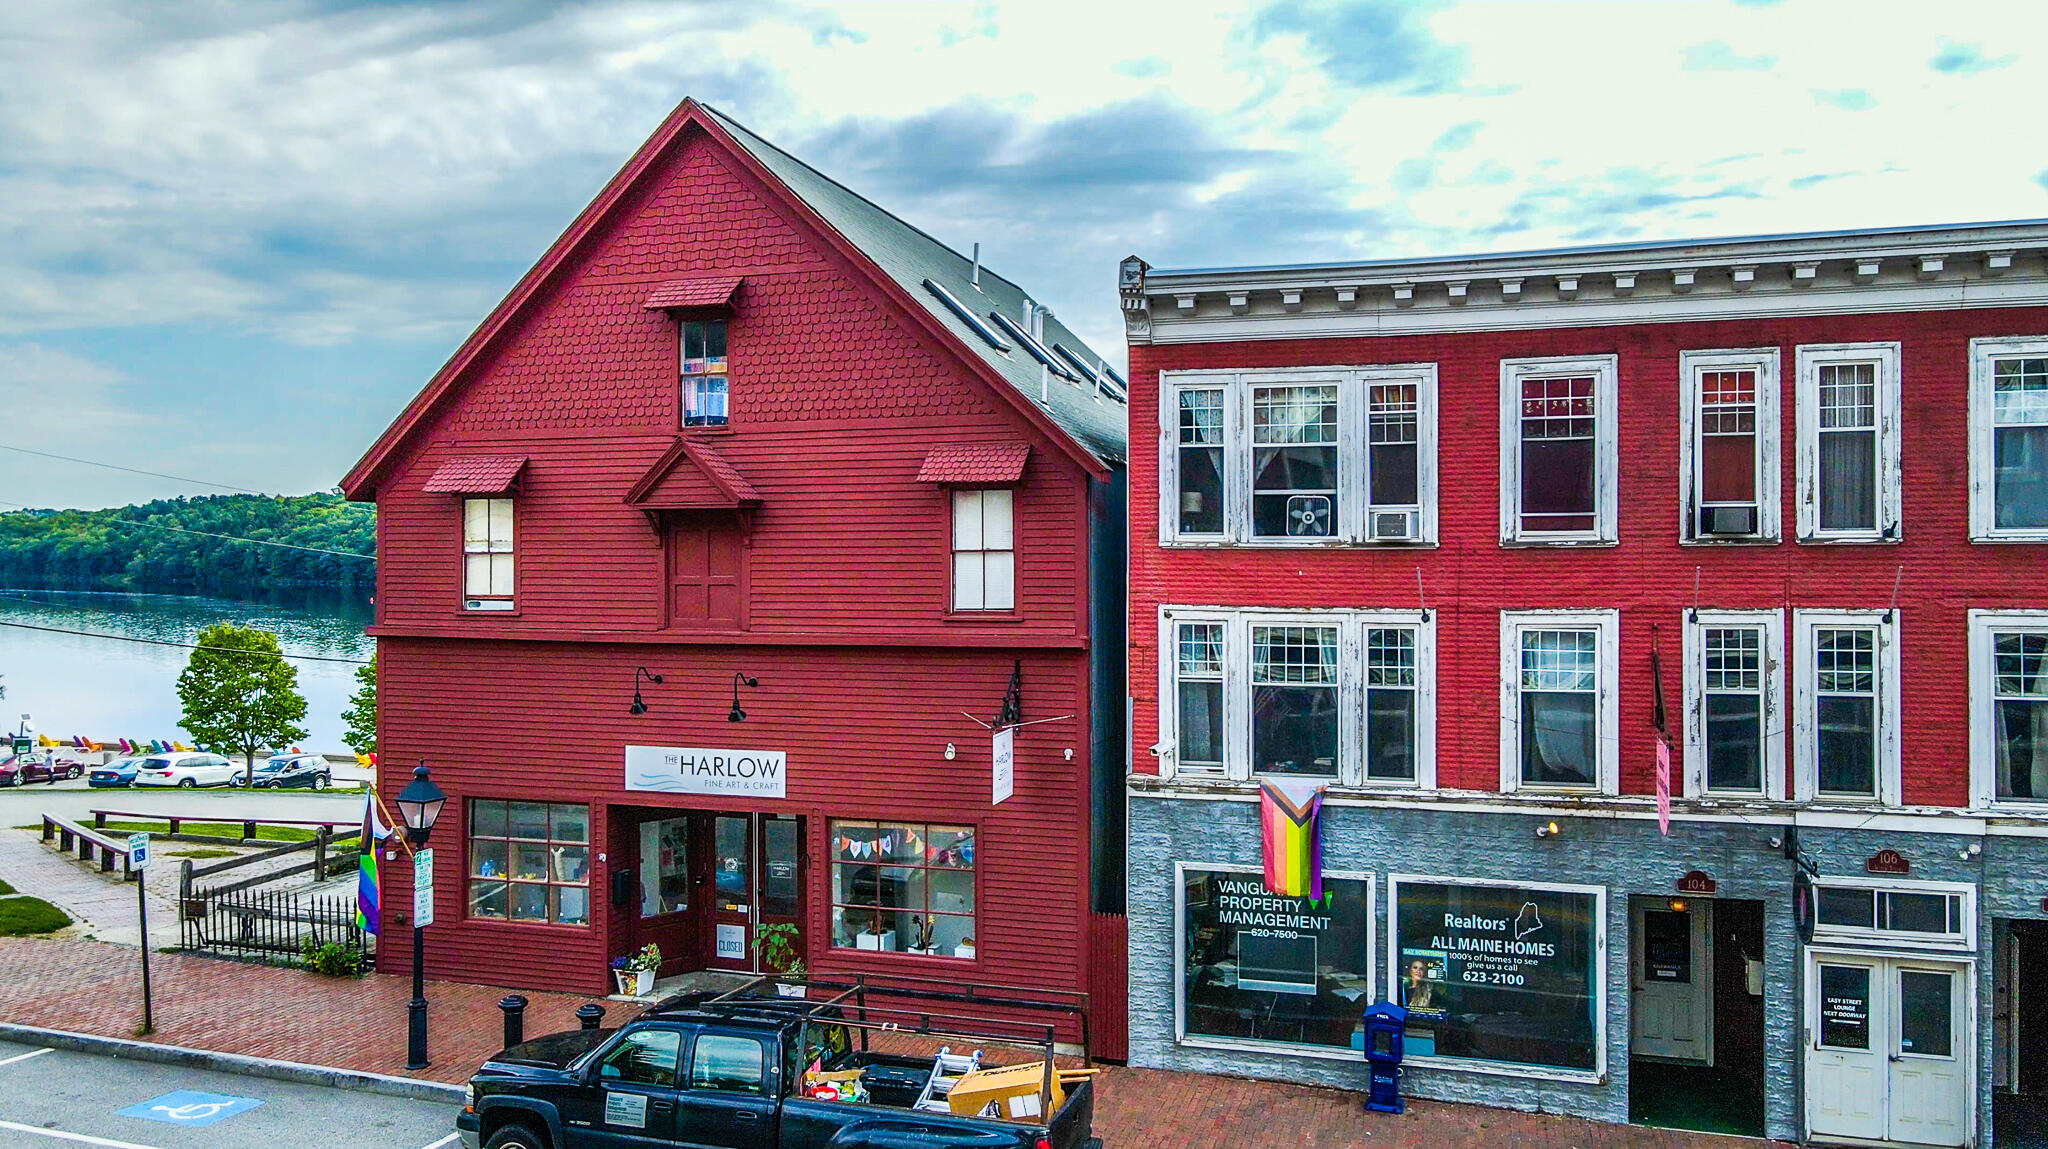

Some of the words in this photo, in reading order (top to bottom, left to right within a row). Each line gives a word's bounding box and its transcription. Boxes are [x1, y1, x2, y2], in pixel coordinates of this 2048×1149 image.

[665, 755, 678, 764] THE
[680, 755, 779, 779] HARLOW
[704, 780, 723, 789] FINE
[726, 781, 741, 790] ART
[743, 781, 750, 790] &
[753, 782, 779, 791] CRAFT
[1880, 852, 1898, 864] 106
[1218, 879, 1285, 897] VANGU
[1687, 879, 1705, 890] 104
[1220, 895, 1302, 913] PROPERTY
[1219, 910, 1331, 930] MANAGEMENT
[1251, 928, 1298, 939] 620-7500
[718, 940, 743, 953] CLOSED
[1431, 935, 1456, 950] ALL
[1457, 937, 1503, 953] MAINE
[1504, 941, 1555, 957] HOMES
[1448, 952, 1472, 960] 1000's
[1473, 953, 1483, 961] of
[1484, 954, 1512, 964] homes
[1513, 957, 1523, 965] to
[1524, 958, 1538, 966] see
[1466, 961, 1485, 970] give
[1503, 964, 1518, 972] call
[1462, 970, 1525, 986] 623-2100
